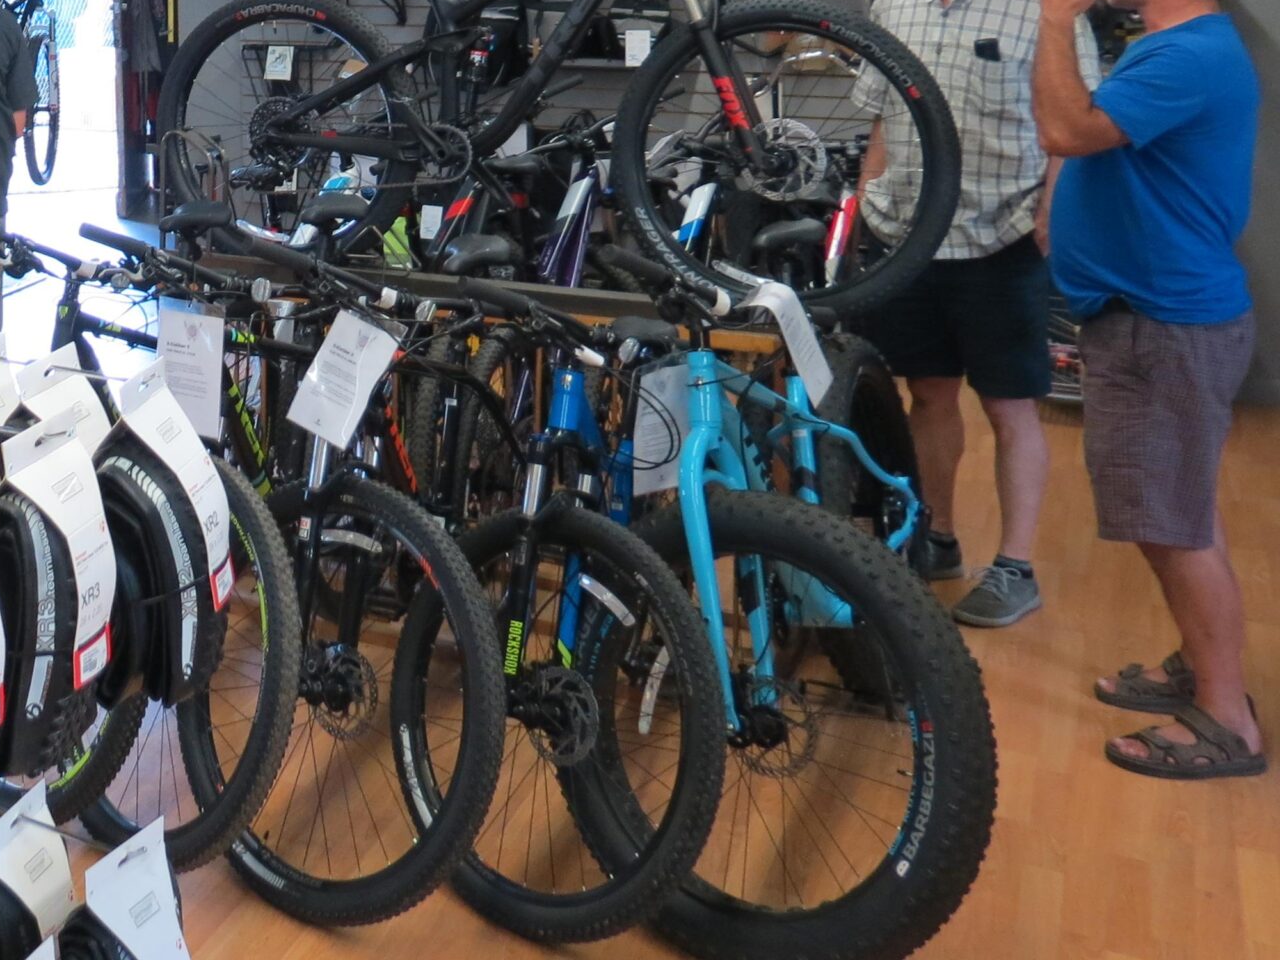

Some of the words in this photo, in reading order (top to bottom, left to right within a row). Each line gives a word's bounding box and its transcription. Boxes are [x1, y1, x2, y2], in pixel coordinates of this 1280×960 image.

[712, 76, 751, 130] FOX
[634, 207, 714, 289] ONTRAGER
[203, 510, 220, 535] XR2
[81, 582, 101, 609] XR3
[178, 566, 198, 620] XR2
[37, 598, 56, 653] XR3
[503, 620, 524, 675] ROCKSHOX
[902, 733, 936, 861] BARBEGAZI
